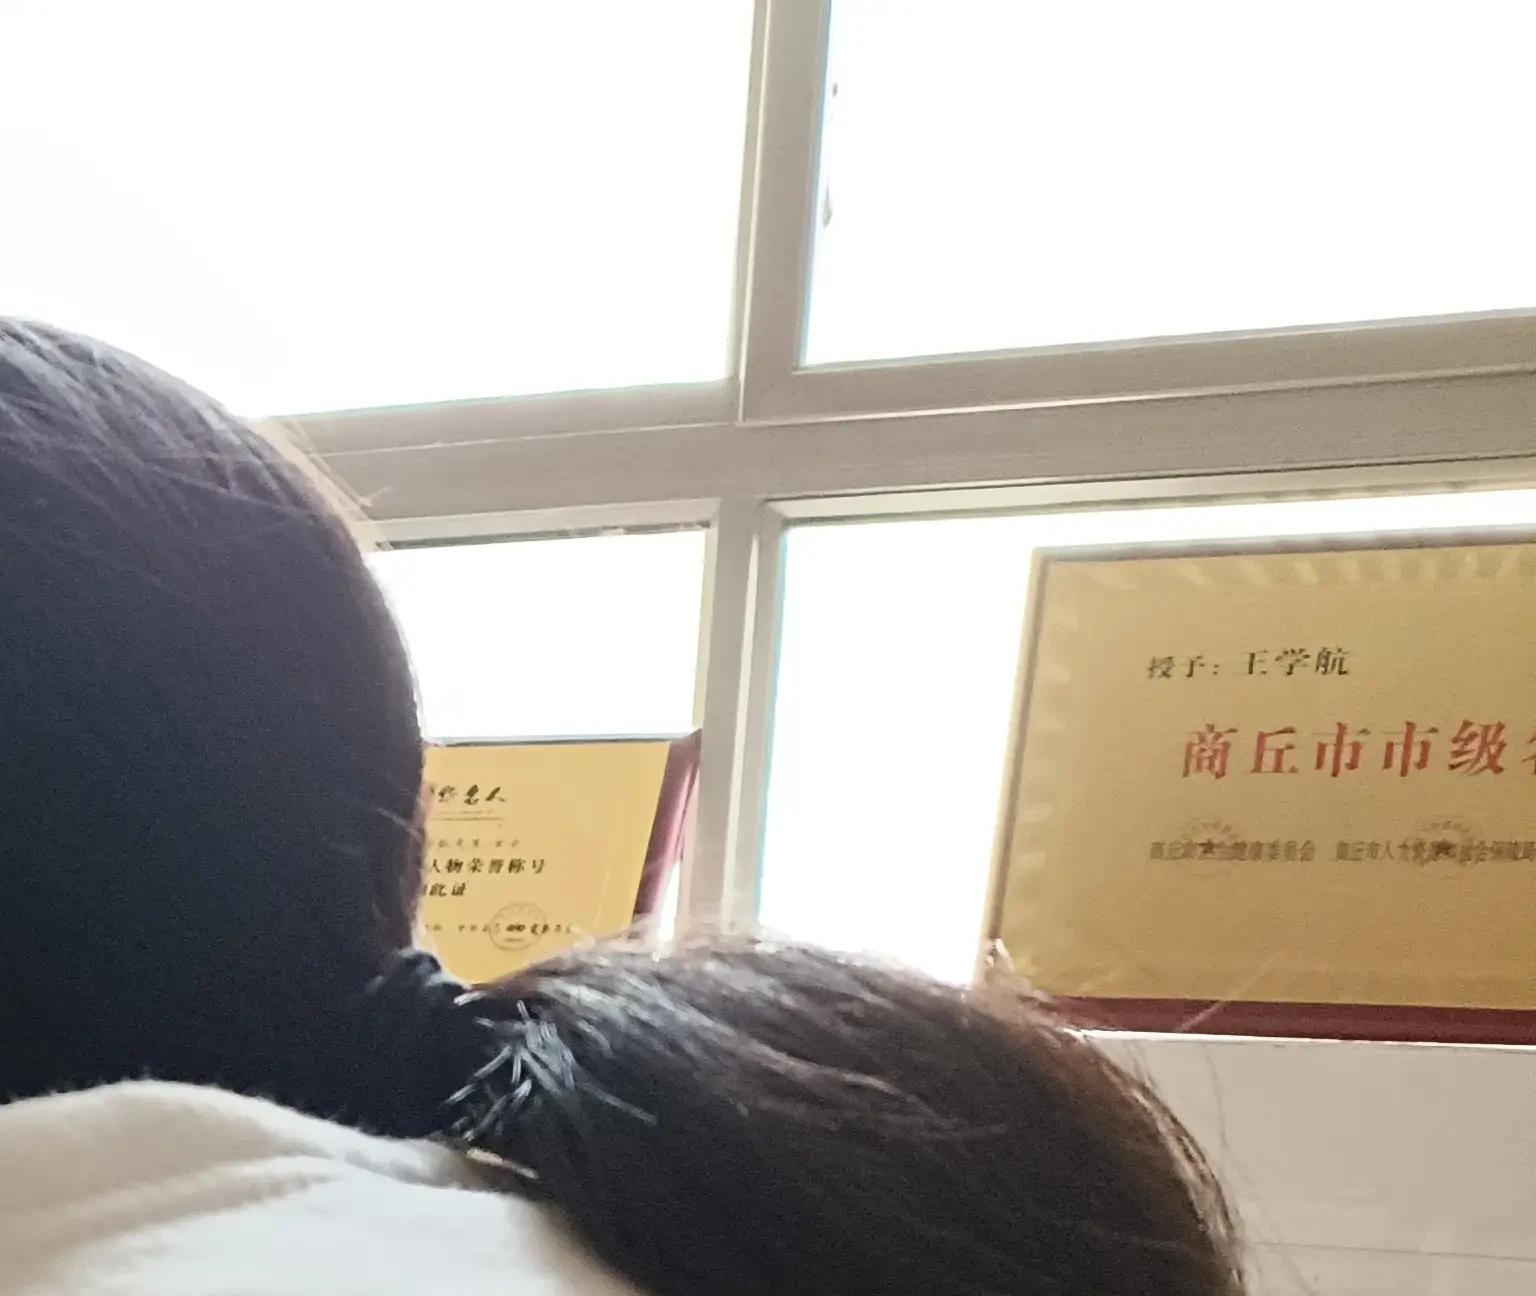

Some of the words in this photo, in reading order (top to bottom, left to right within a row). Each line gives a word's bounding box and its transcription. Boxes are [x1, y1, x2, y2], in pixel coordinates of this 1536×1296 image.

[1181, 718, 1536, 780] 商丘市市级
